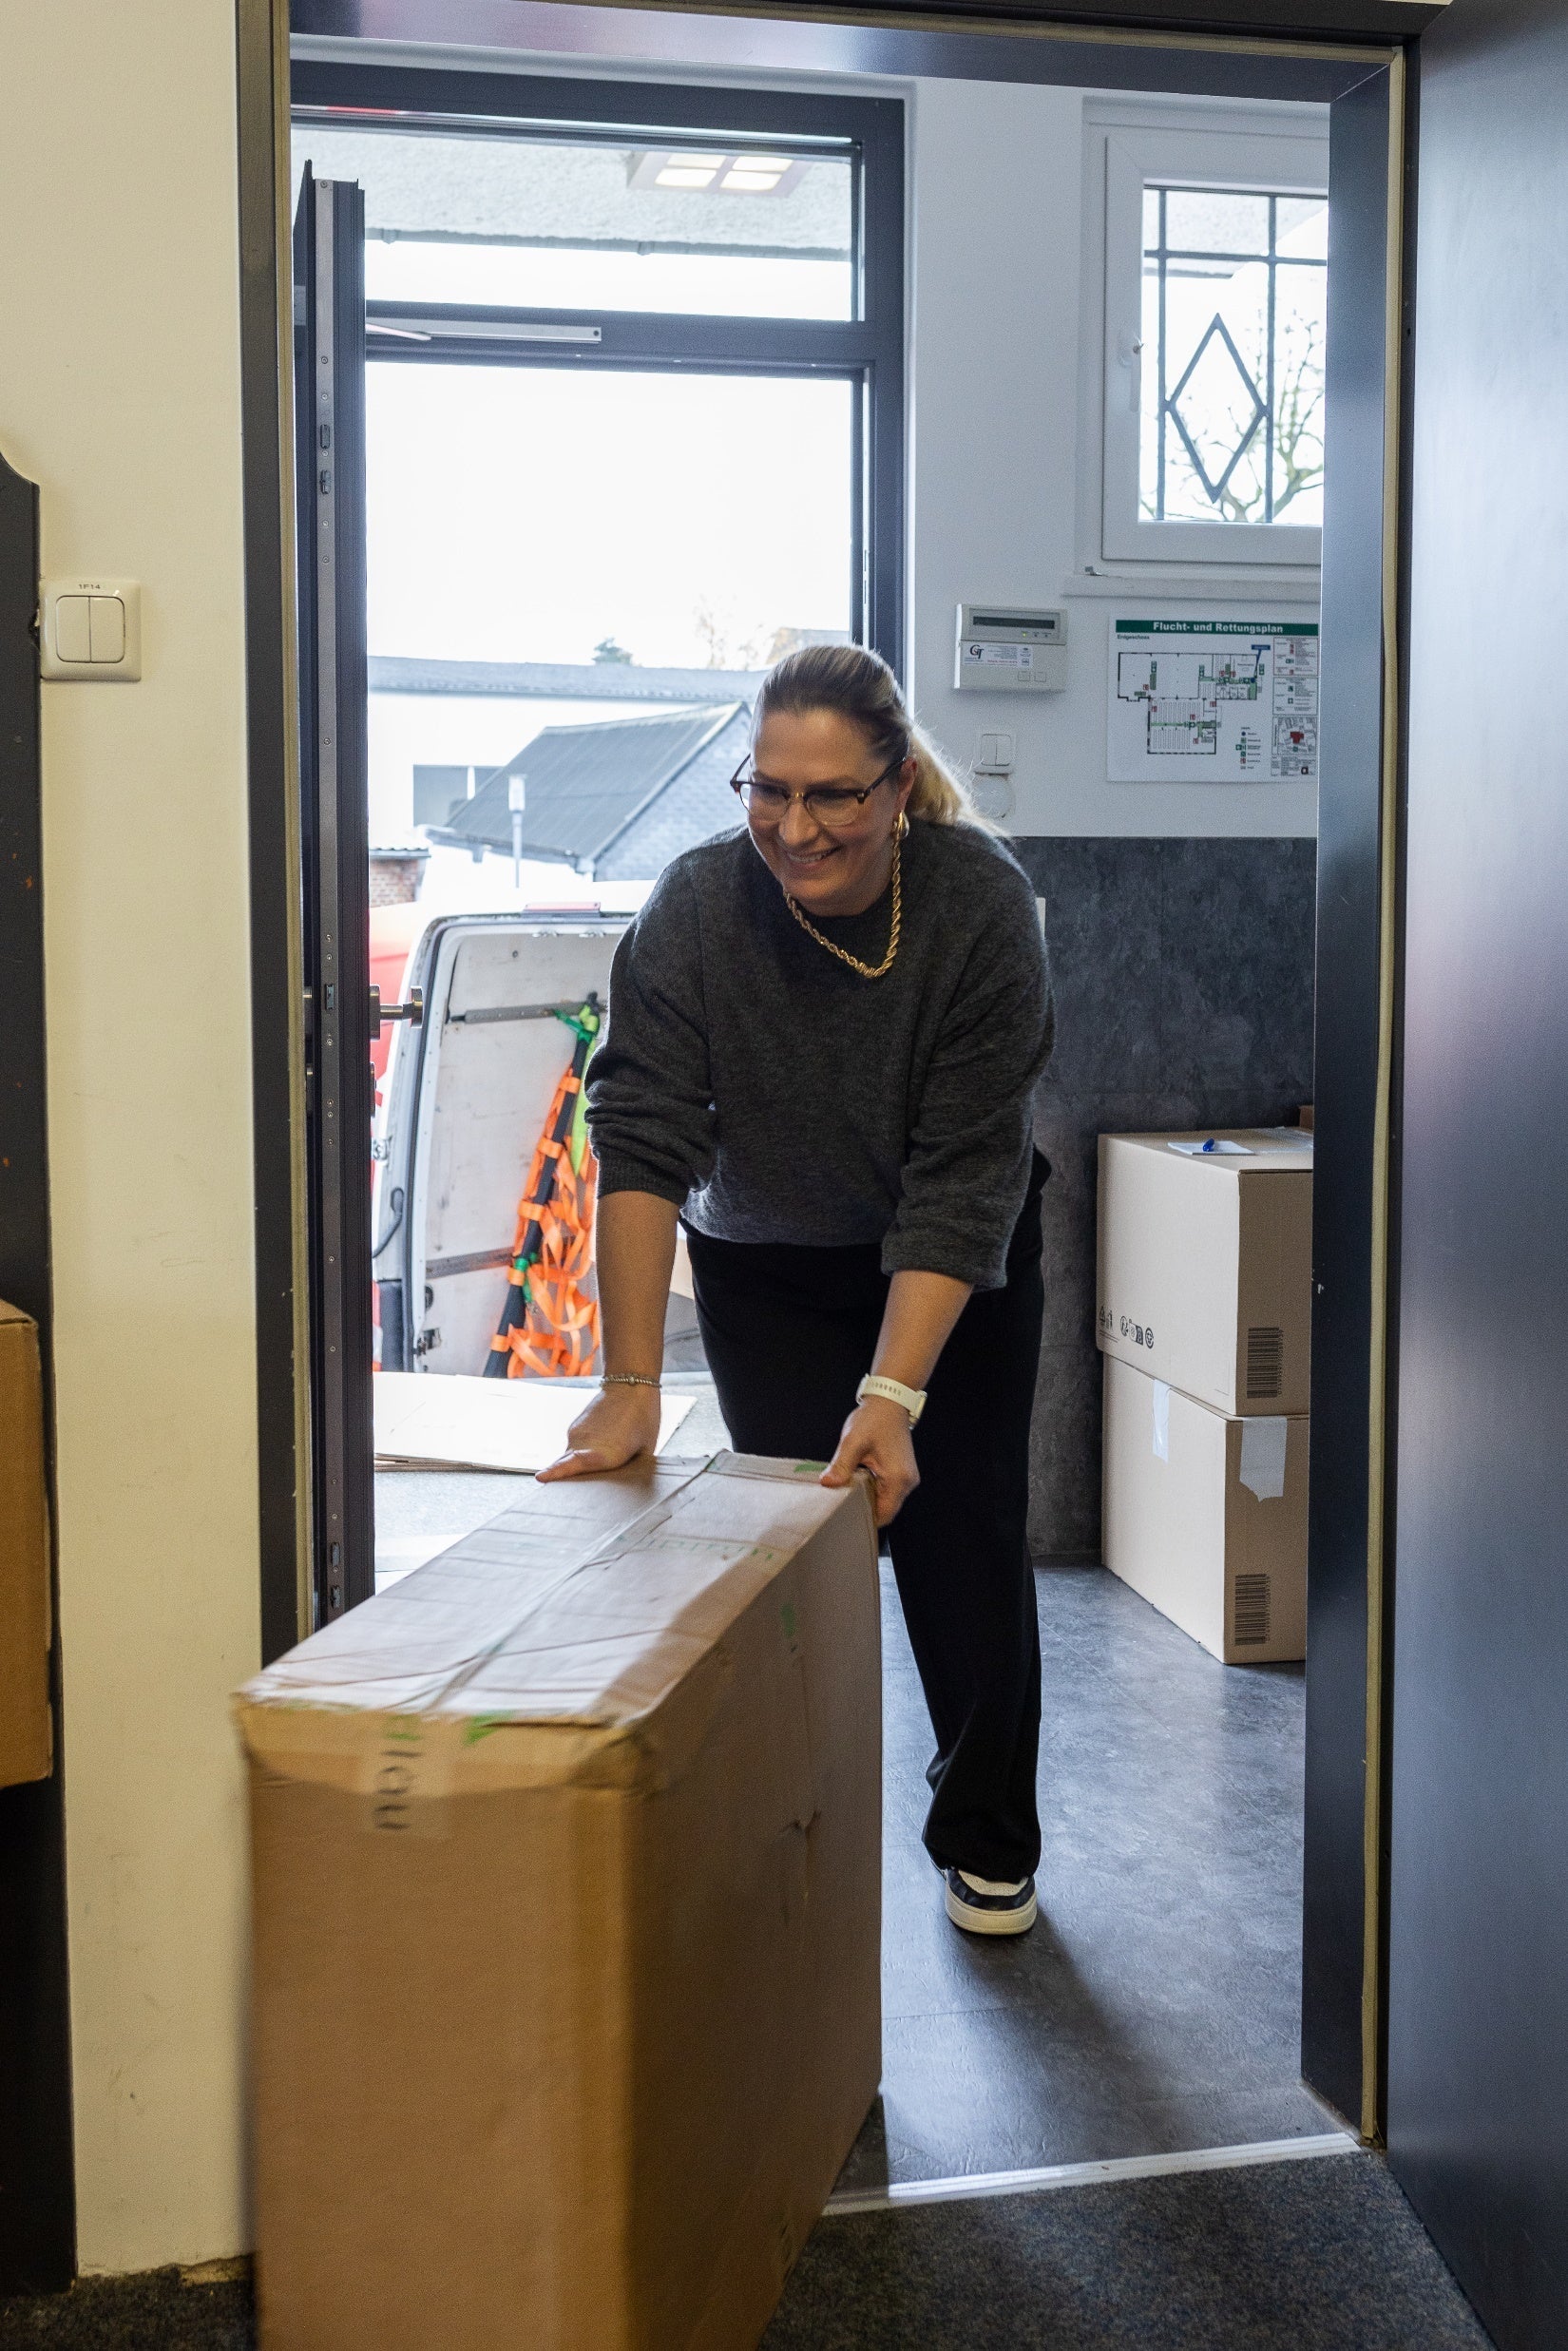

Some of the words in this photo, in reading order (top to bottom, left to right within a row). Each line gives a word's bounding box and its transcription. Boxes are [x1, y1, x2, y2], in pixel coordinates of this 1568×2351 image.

[1153, 621, 1191, 631] Flucht-
[1193, 622, 1213, 632] und
[1215, 622, 1284, 635] Rettungsplan
